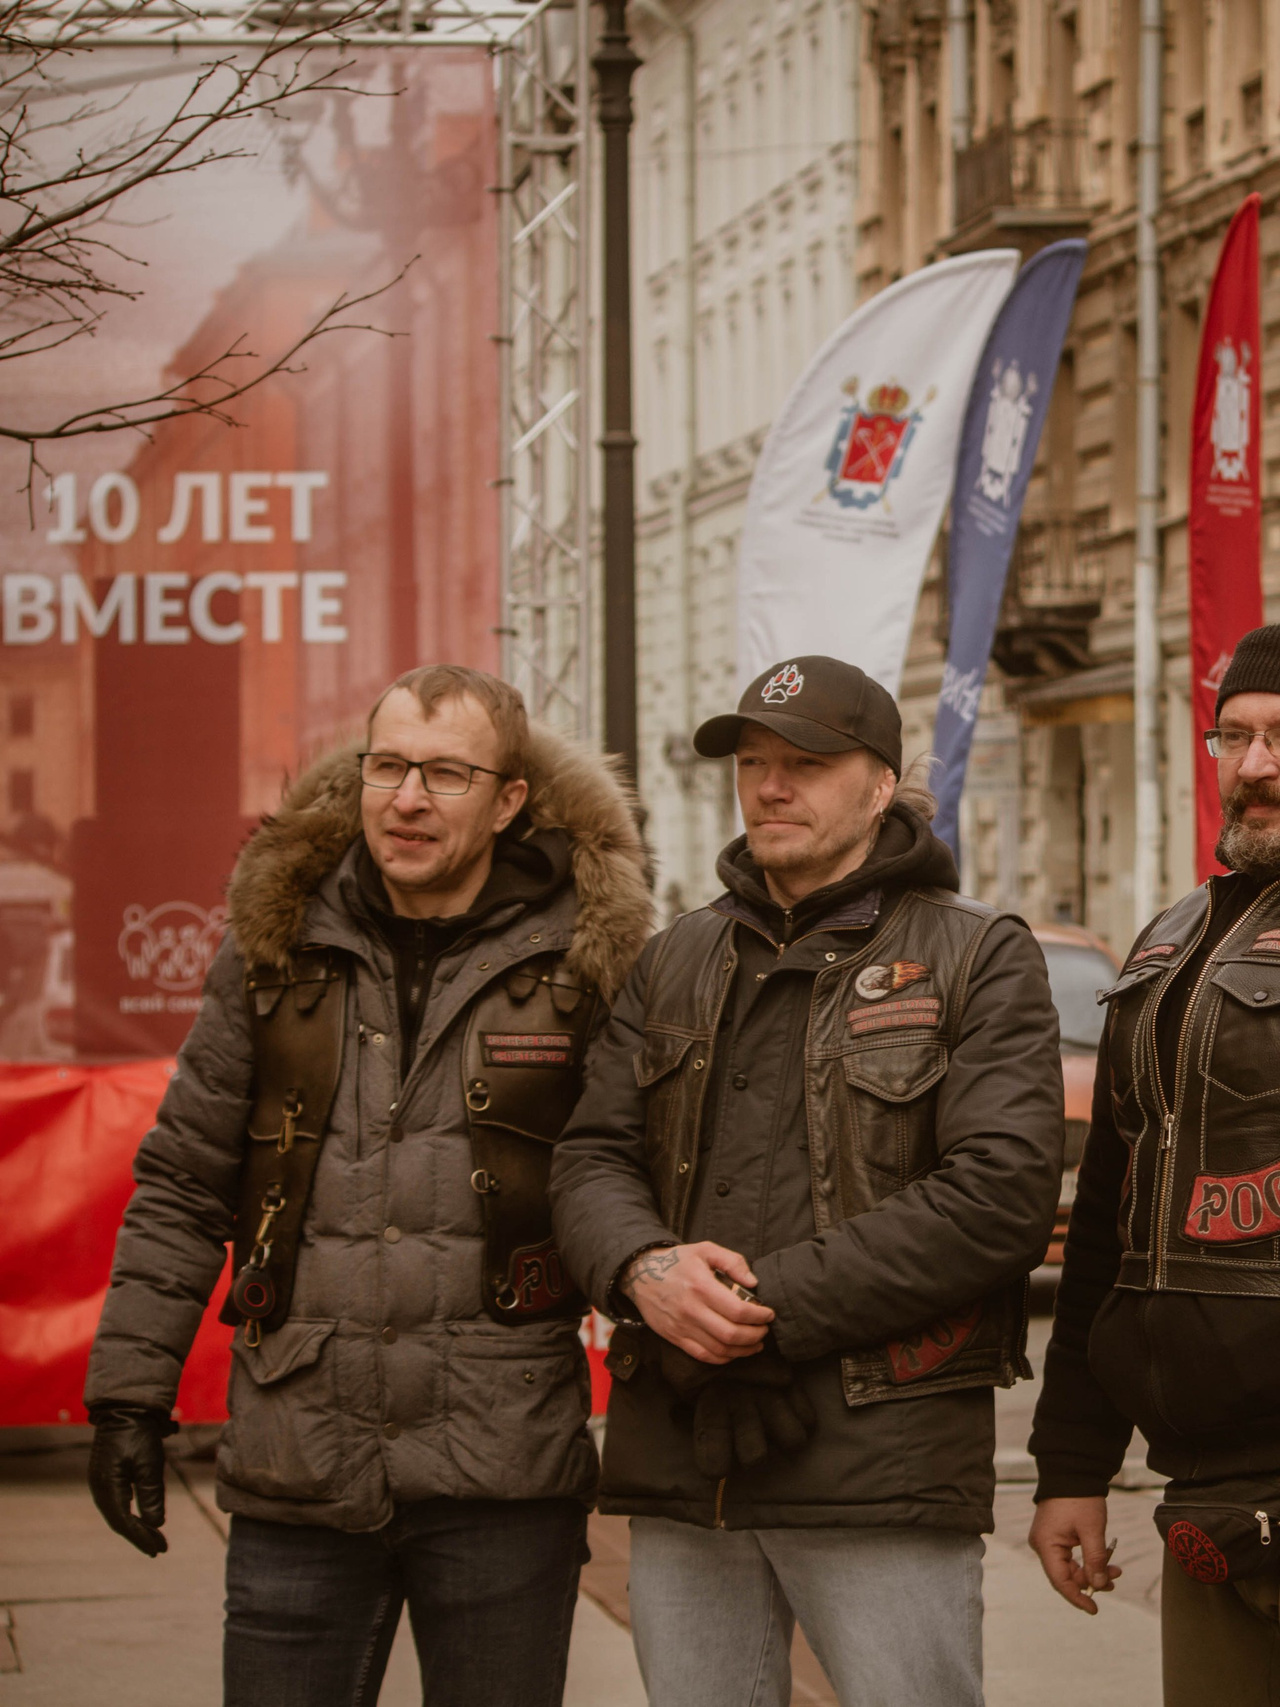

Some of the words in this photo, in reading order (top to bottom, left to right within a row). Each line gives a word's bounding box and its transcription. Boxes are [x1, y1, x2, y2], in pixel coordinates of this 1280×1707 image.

[42, 471, 140, 543] 10
[157, 471, 329, 543] ЛЕТ
[2, 571, 348, 645] ВМЕСТЕ
